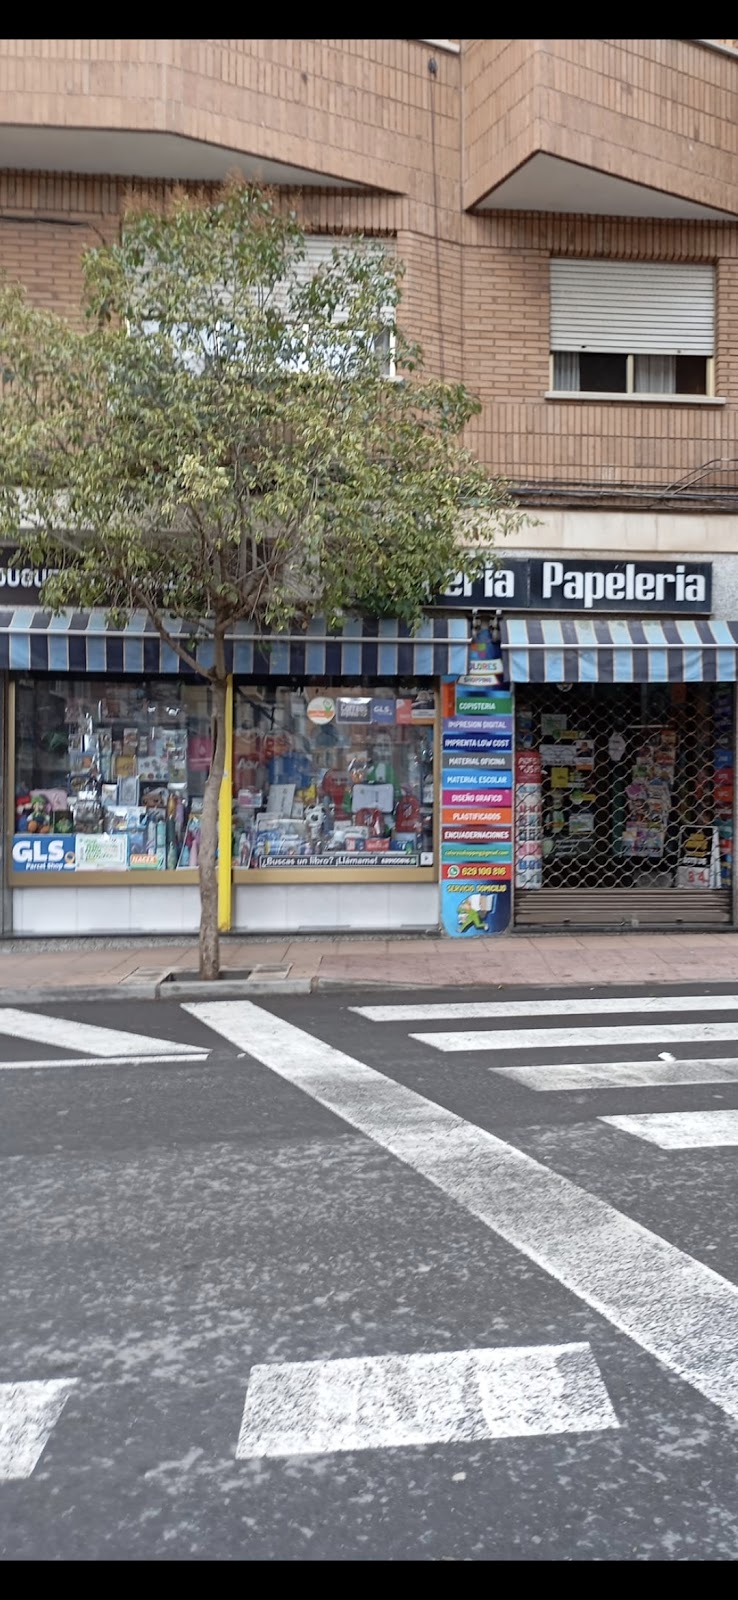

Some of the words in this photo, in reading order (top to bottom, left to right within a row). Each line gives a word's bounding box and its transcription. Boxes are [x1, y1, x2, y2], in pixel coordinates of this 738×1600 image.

[440, 560, 515, 598] eria
[542, 561, 706, 608] Papeleria
[373, 705, 390, 713] GLS
[459, 702, 496, 710] COPISTERIA
[447, 720, 482, 729] IMPRESION
[482, 720, 507, 729] DIGITAL
[444, 738, 477, 747] IMPRENTA
[477, 738, 492, 747] LOW
[492, 739, 510, 748] COST
[448, 757, 480, 766] MATERIAL
[480, 757, 506, 766] OFICINA
[447, 775, 478, 784] MATERIAL
[478, 776, 507, 784] ESCOLAR
[451, 792, 475, 803] DISEÑO
[475, 794, 503, 802] GRAFICO
[452, 812, 502, 821] PLASTIFICADOS
[444, 831, 510, 840] ENCUADERNACIONES
[12, 840, 65, 863] GLS
[26, 863, 46, 871] Parcel
[261, 857, 295, 868] ¿Buscas
[309, 857, 334, 867] libro?
